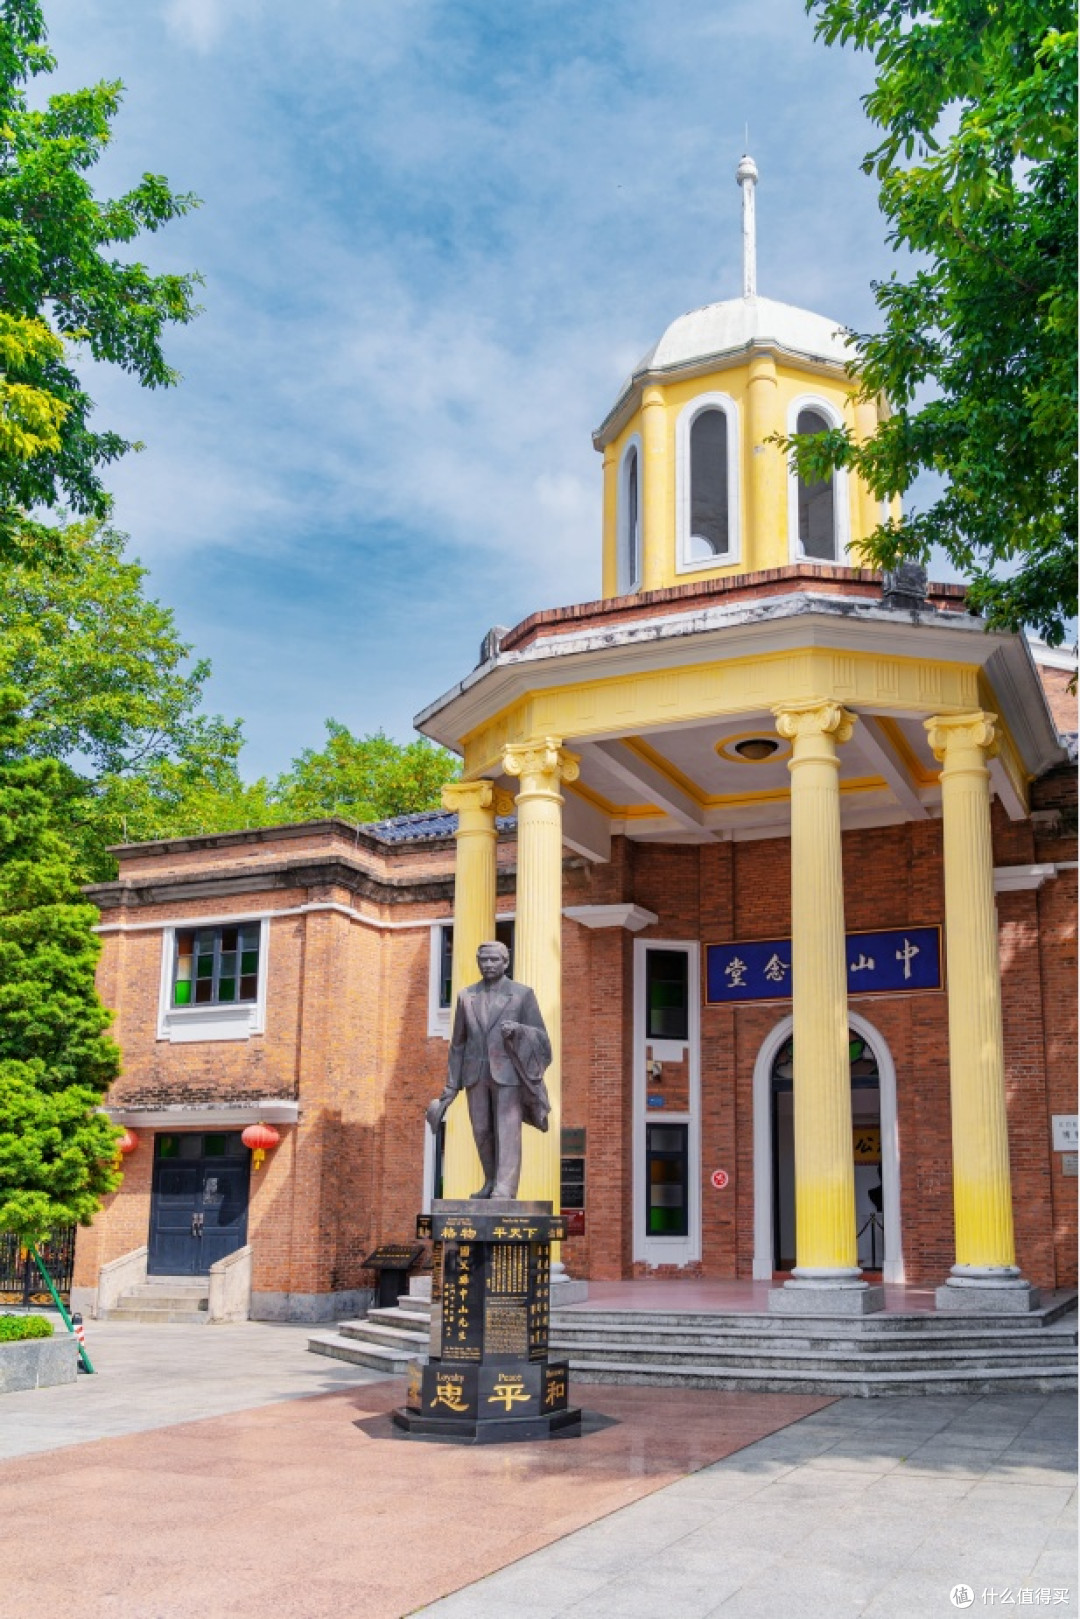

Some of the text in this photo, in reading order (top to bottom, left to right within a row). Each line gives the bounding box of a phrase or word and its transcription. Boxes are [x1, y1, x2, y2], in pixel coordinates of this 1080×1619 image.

[724, 938, 920, 988] 中山念堂
[492, 1226, 538, 1239] 平天下
[436, 1372, 465, 1384] Loyalty
[498, 1373, 522, 1382] Peace
[430, 1382, 470, 1412] 忠
[488, 1383, 532, 1412] 平
[545, 1380, 565, 1406] 和
